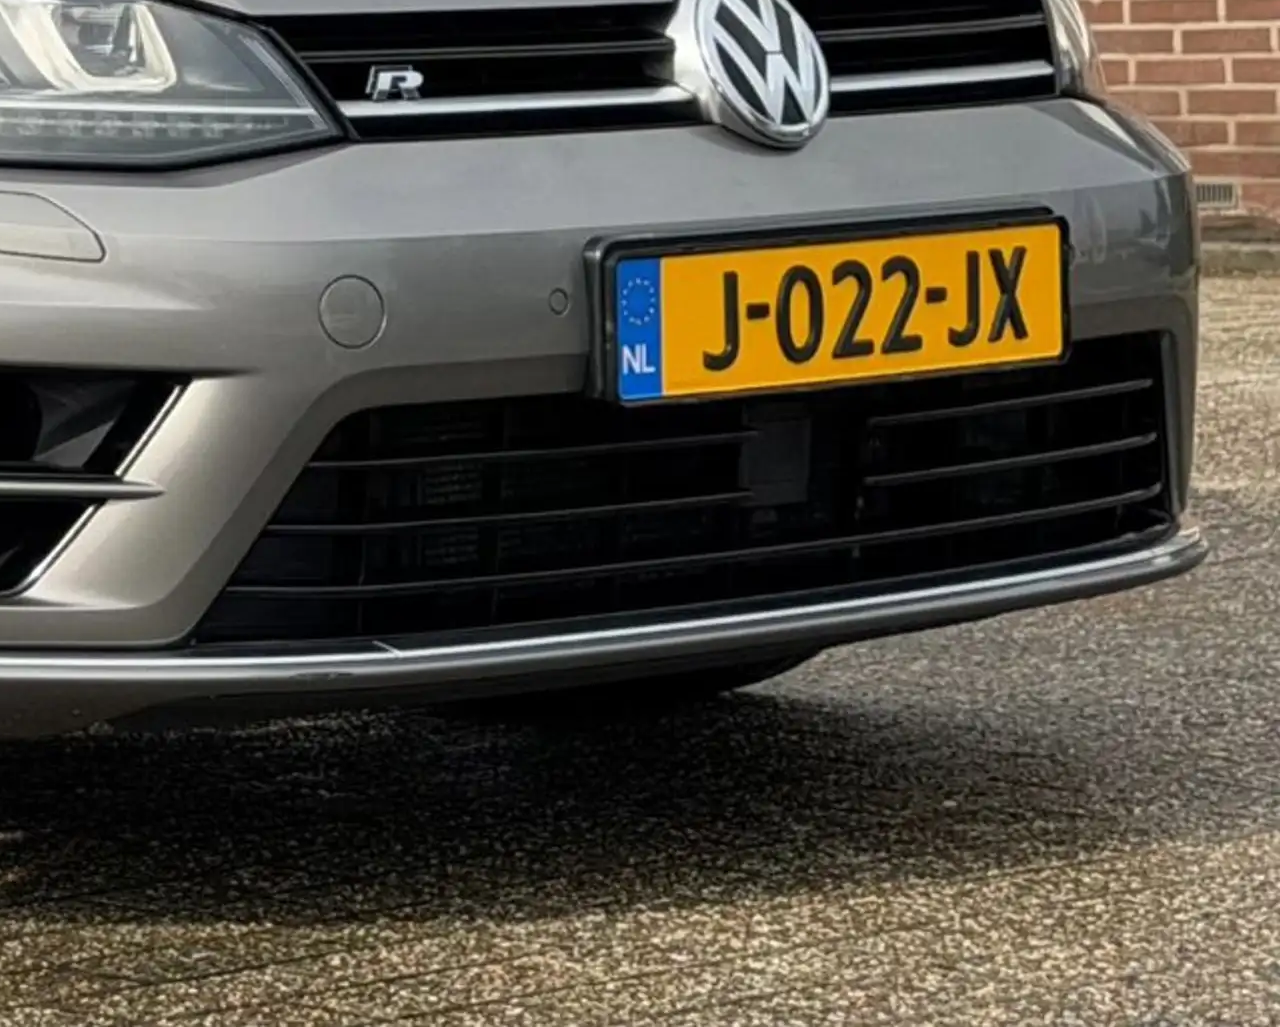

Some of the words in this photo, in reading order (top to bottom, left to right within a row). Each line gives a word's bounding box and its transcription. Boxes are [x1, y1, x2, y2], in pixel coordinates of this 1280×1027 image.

[366, 64, 424, 102] R
[701, 244, 1030, 373] J-022-JX
[621, 343, 656, 375] NL
